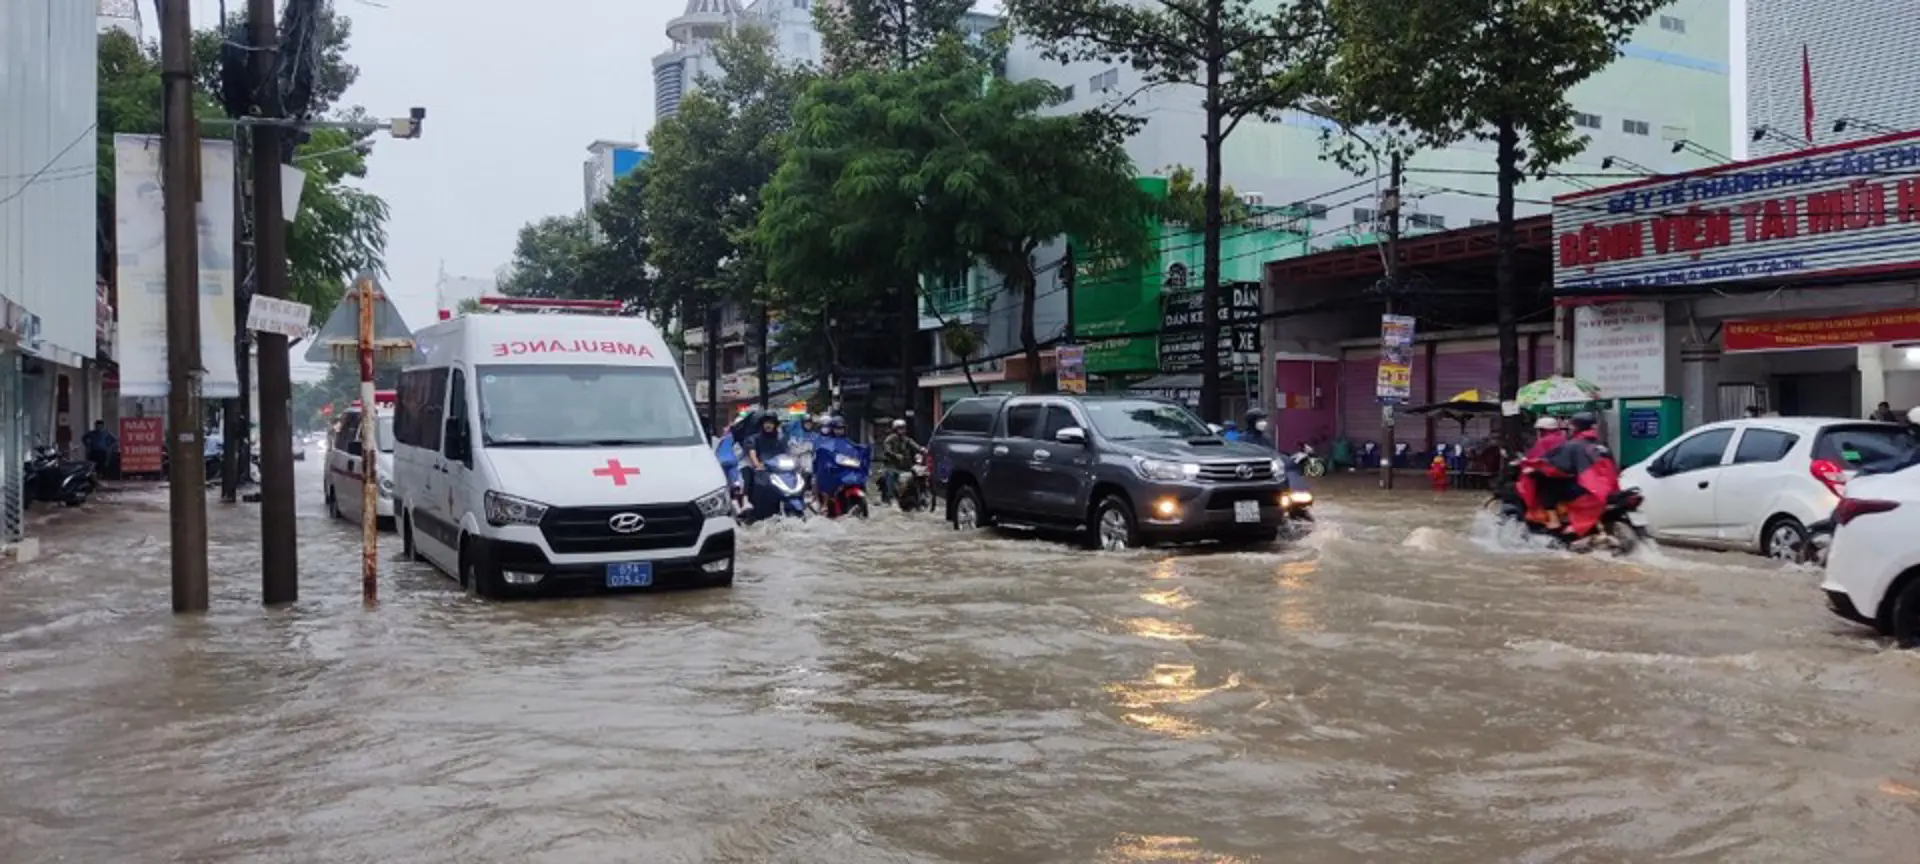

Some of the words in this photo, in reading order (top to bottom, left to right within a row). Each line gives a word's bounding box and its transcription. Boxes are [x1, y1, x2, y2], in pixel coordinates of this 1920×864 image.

[1641, 191, 1654, 208] Y
[1559, 222, 1643, 274] BỆNH
[1651, 204, 1731, 261] VIỆN
[1740, 196, 1798, 242] TAI
[1807, 179, 1885, 235] MŨI
[1233, 284, 1259, 307] DÁN
[1238, 332, 1255, 351] XE
